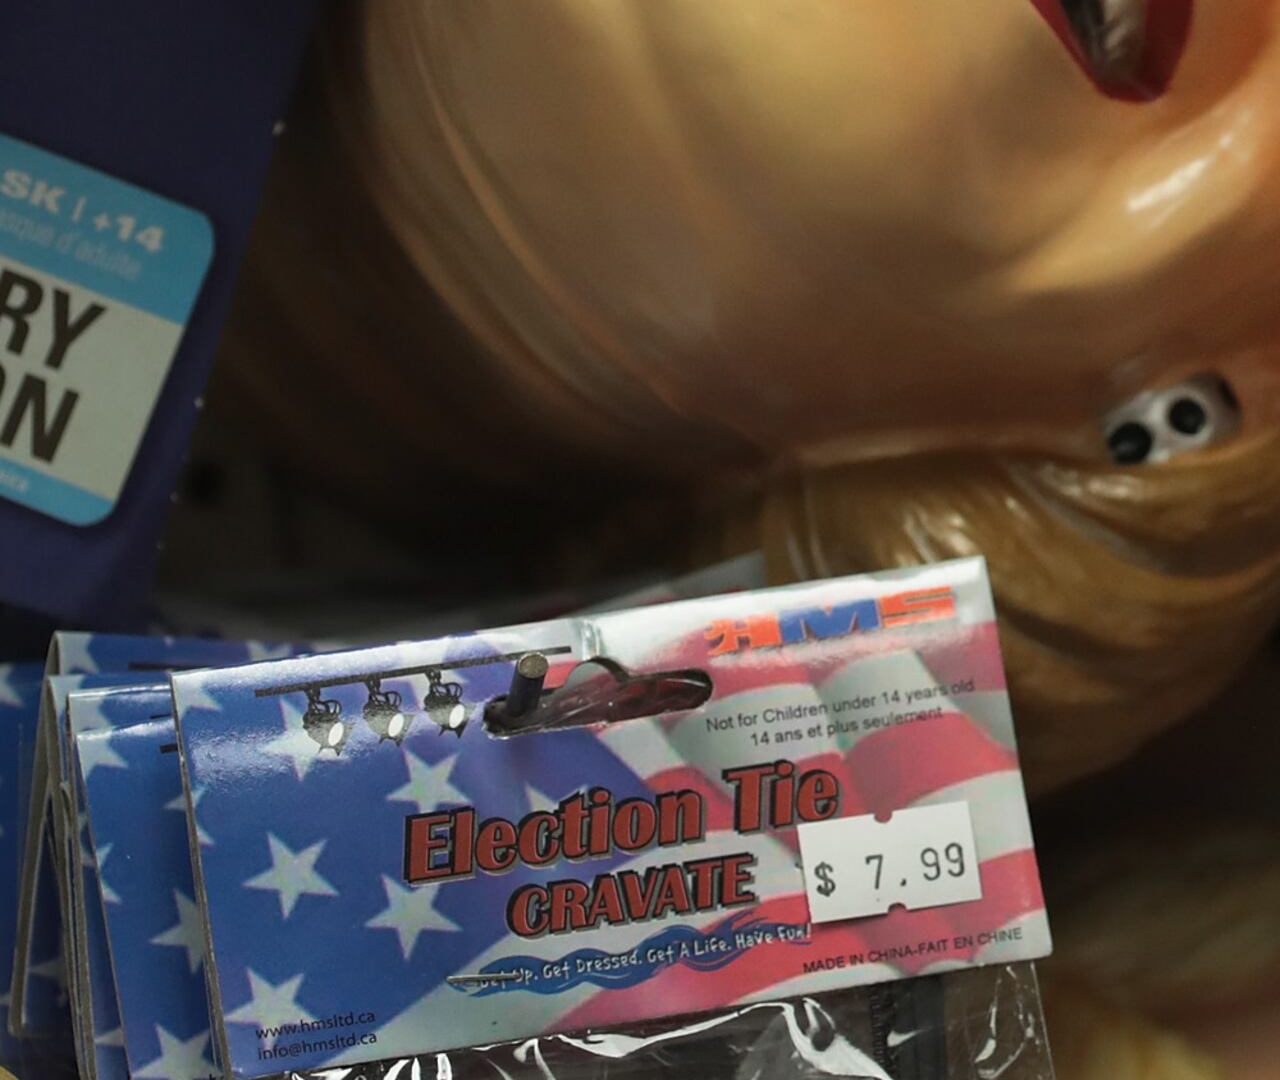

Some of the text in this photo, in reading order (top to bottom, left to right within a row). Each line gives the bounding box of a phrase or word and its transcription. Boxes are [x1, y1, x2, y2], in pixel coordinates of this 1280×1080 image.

[92, 212, 164, 254] +14
[0, 267, 107, 370] RY
[0, 359, 80, 464] N
[703, 585, 956, 656] HMS
[706, 678, 976, 733] Not for Children under 14 years old
[750, 706, 943, 747] 14 ans et plus seulement
[404, 760, 840, 884] Election Tie
[506, 852, 760, 939] CRAVATE
[814, 842, 966, 897] $ 7.99
[543, 961, 571, 980] Get
[576, 951, 643, 974] Dressed.
[647, 945, 673, 965] Get
[679, 942, 690, 958] A
[735, 929, 774, 951] Have
[777, 922, 812, 942] Fun!
[802, 926, 1023, 975] MADE IN CHINA-FAIT EN CHINE
[255, 1010, 376, 1040] www.hmsltd.ca
[257, 1031, 378, 1061] info@hmsltd.ca
